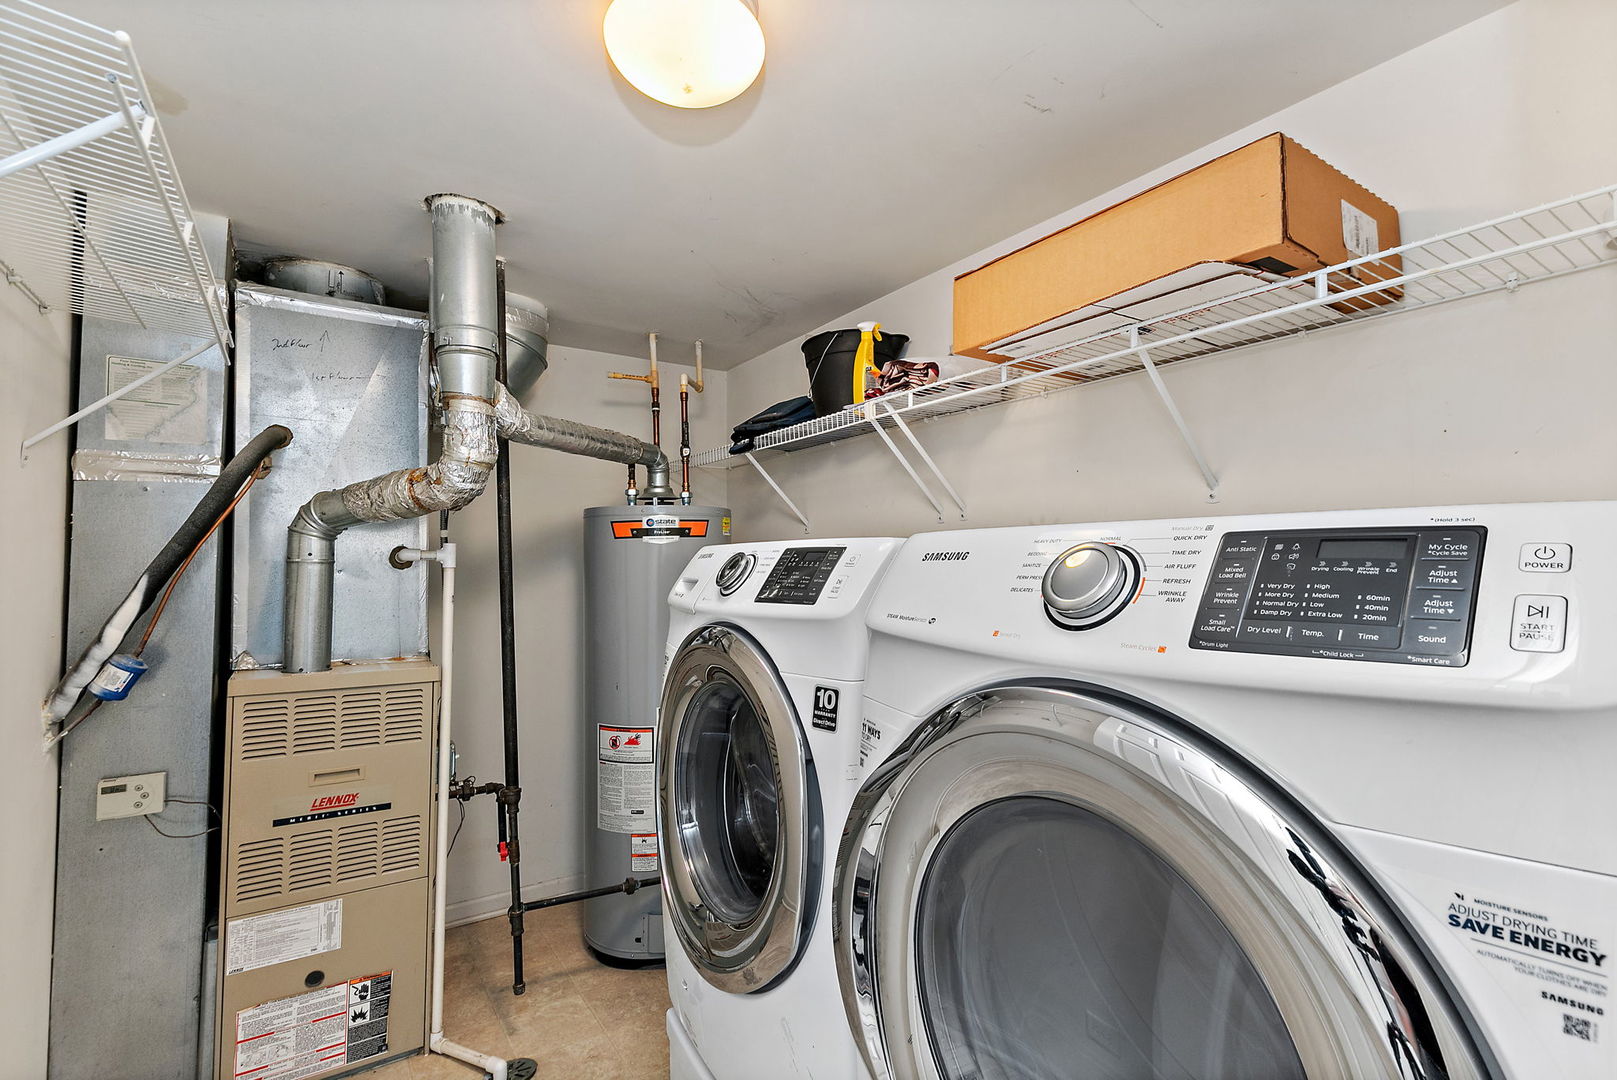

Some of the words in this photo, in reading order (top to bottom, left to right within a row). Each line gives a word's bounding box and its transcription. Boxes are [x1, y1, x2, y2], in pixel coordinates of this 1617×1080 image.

[921, 551, 970, 562] SAMSUNG
[1524, 561, 1564, 569] POWER
[1424, 599, 1453, 607] Adjust
[1279, 609, 1292, 617] Dry
[1423, 606, 1446, 614] Time
[1520, 623, 1554, 631] START
[1302, 629, 1325, 637] Temp.
[1358, 633, 1380, 641] Time
[1418, 635, 1447, 643] Sound
[817, 689, 836, 710] 10
[814, 710, 836, 718] WARRANTY
[311, 792, 360, 809] LENNOX
[337, 806, 377, 816] SERIES
[1474, 898, 1511, 913] MOISTURE
[1513, 908, 1549, 922] SENSORS
[1448, 902, 1499, 923] ADJUST
[1502, 915, 1558, 940] DRYING
[1560, 930, 1598, 950] TIME
[1448, 914, 1505, 940] SAVE
[1509, 929, 1607, 967] ENERGY
[1476, 949, 1537, 970] AUTOMATICALLY
[1538, 966, 1566, 979] TURNS
[1514, 966, 1535, 977] YOUR
[1541, 991, 1604, 1016] SAMSUNG
